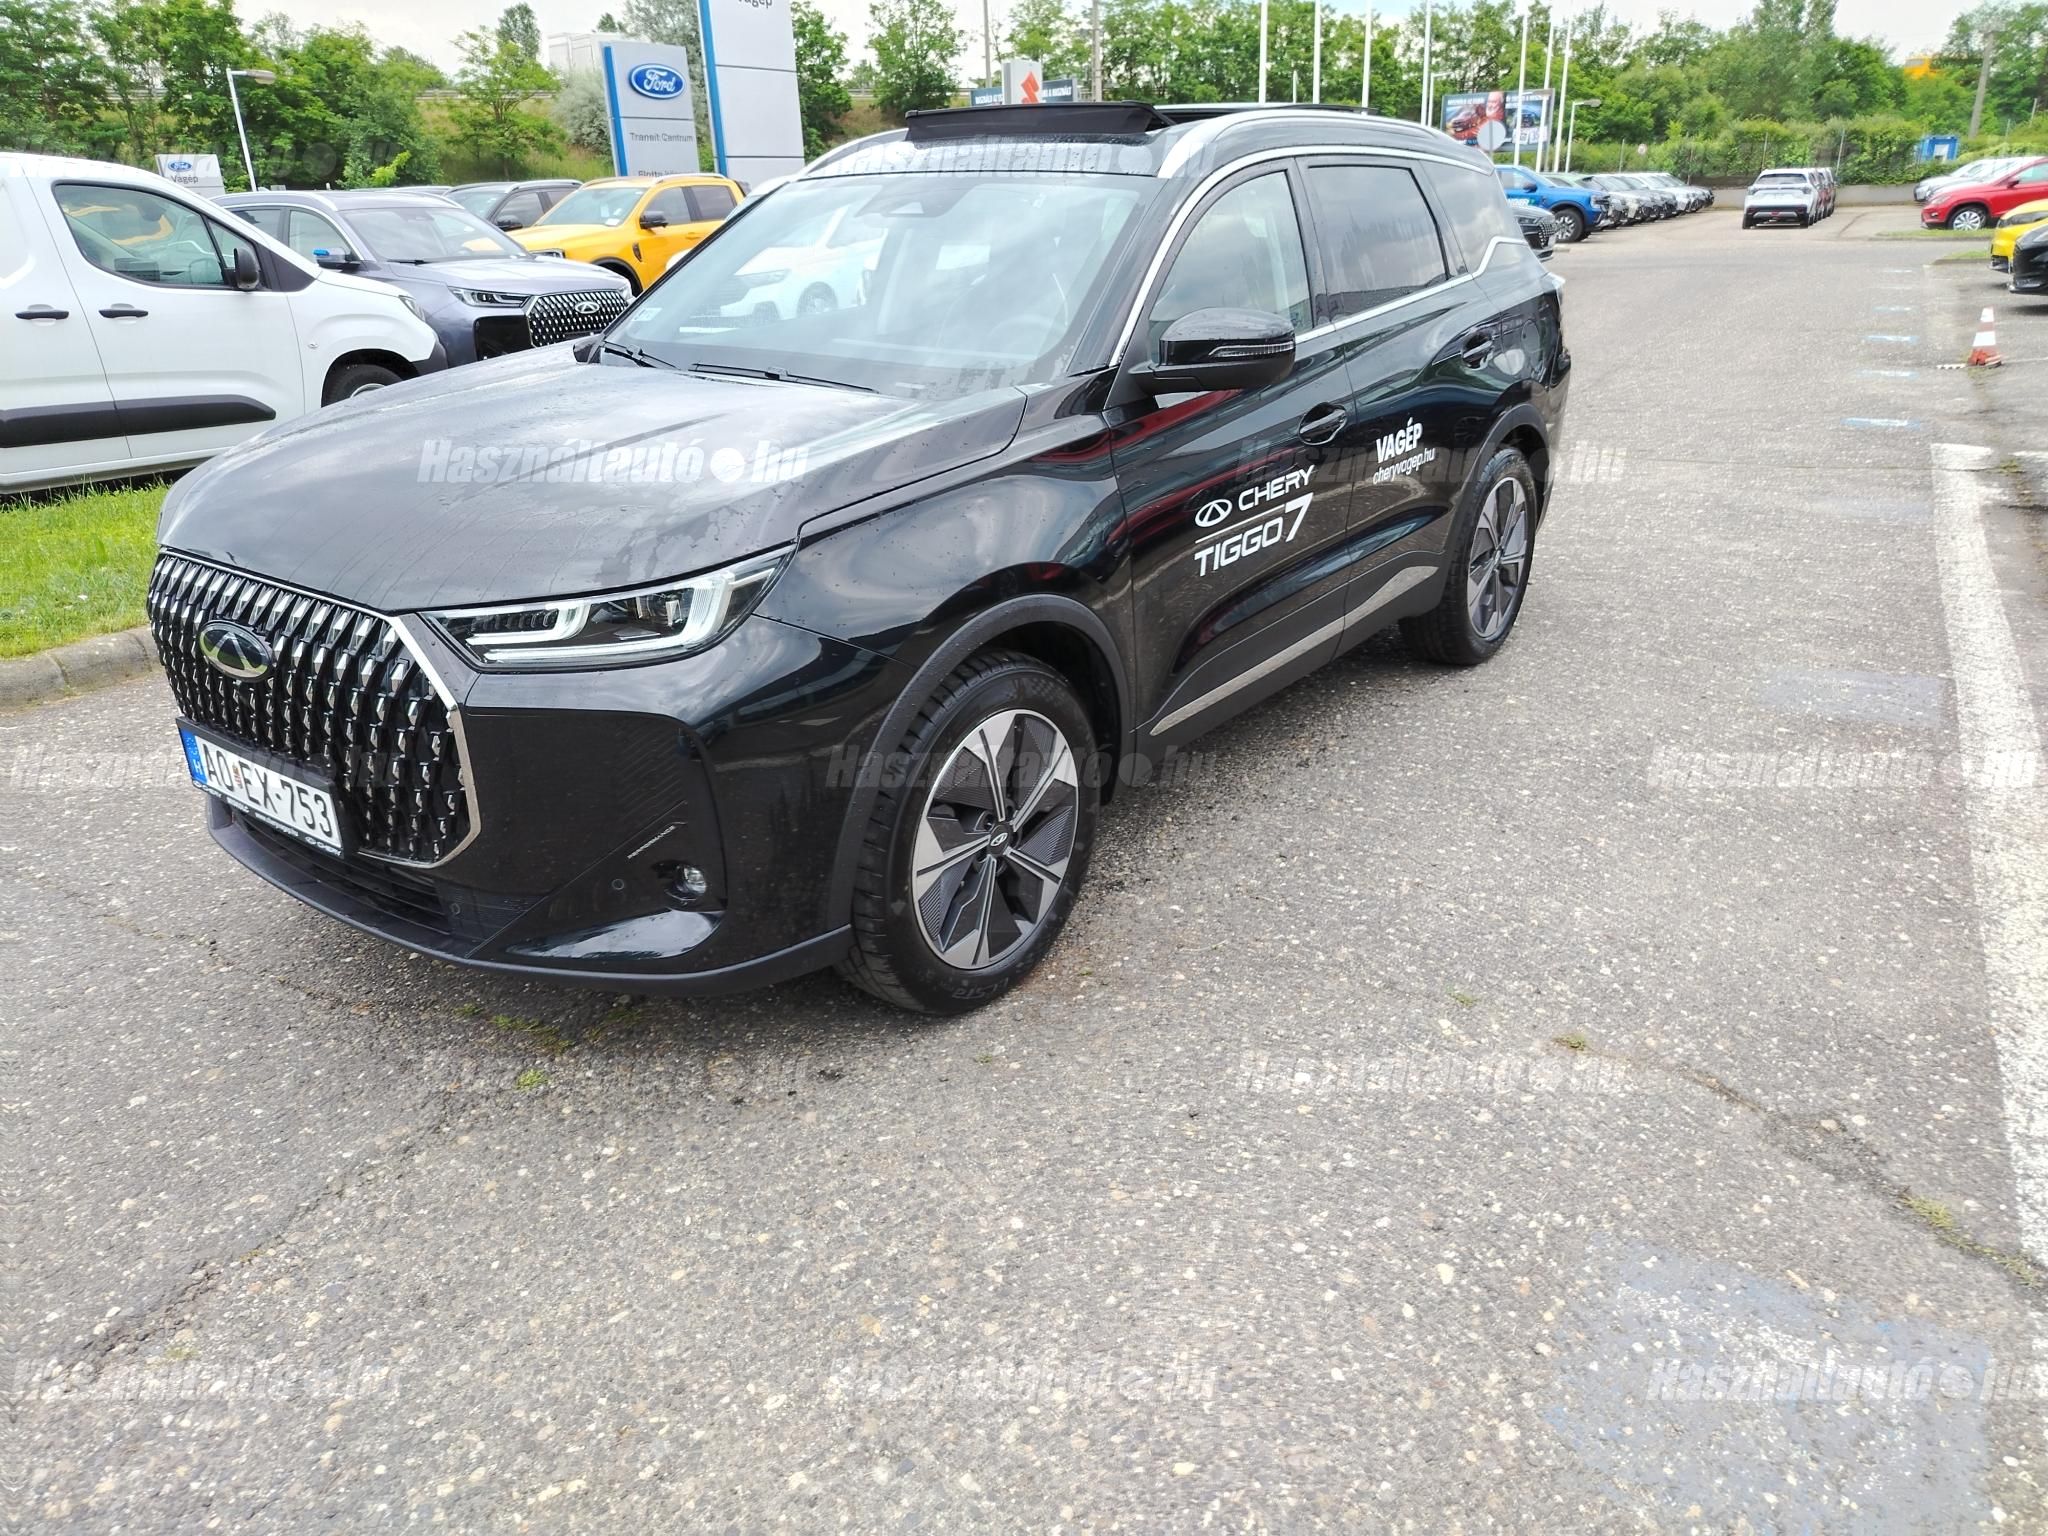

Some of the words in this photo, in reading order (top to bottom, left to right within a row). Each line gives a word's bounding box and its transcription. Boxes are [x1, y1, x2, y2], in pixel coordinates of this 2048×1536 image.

[629, 132, 660, 142] Transit
[662, 133, 694, 142] Centrum
[1376, 417, 1424, 464] VAGÉP
[1237, 464, 1315, 512] CHERY
[1372, 448, 1436, 486] cheryvagep.hu
[238, 760, 334, 838] EX-753
